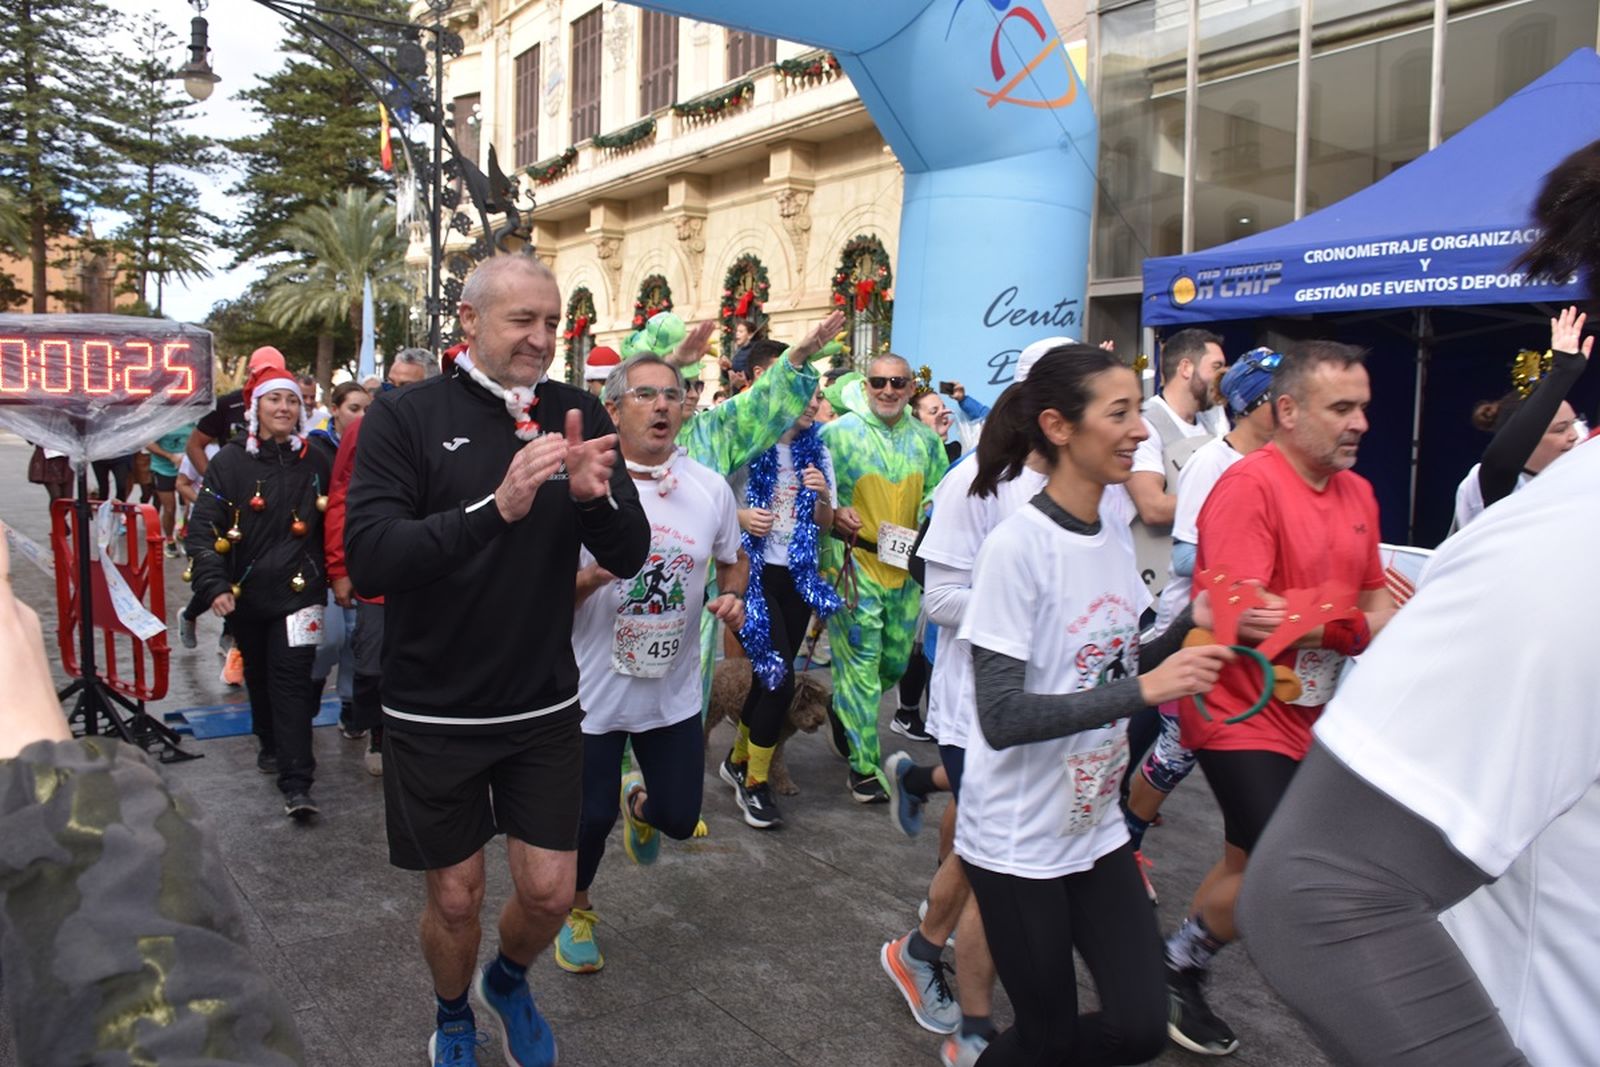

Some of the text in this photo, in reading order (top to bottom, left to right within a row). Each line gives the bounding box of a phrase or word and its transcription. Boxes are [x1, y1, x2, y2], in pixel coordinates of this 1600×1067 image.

[1304, 228, 1548, 264] CRONOMETRAJE ORGANIZACI
[1419, 257, 1432, 273] Y
[1295, 283, 1358, 302] GESTIÓN
[1360, 282, 1382, 298] DE
[1384, 276, 1459, 296] EVENTOS
[983, 286, 1078, 328] Ceuta
[647, 638, 680, 659] 459
